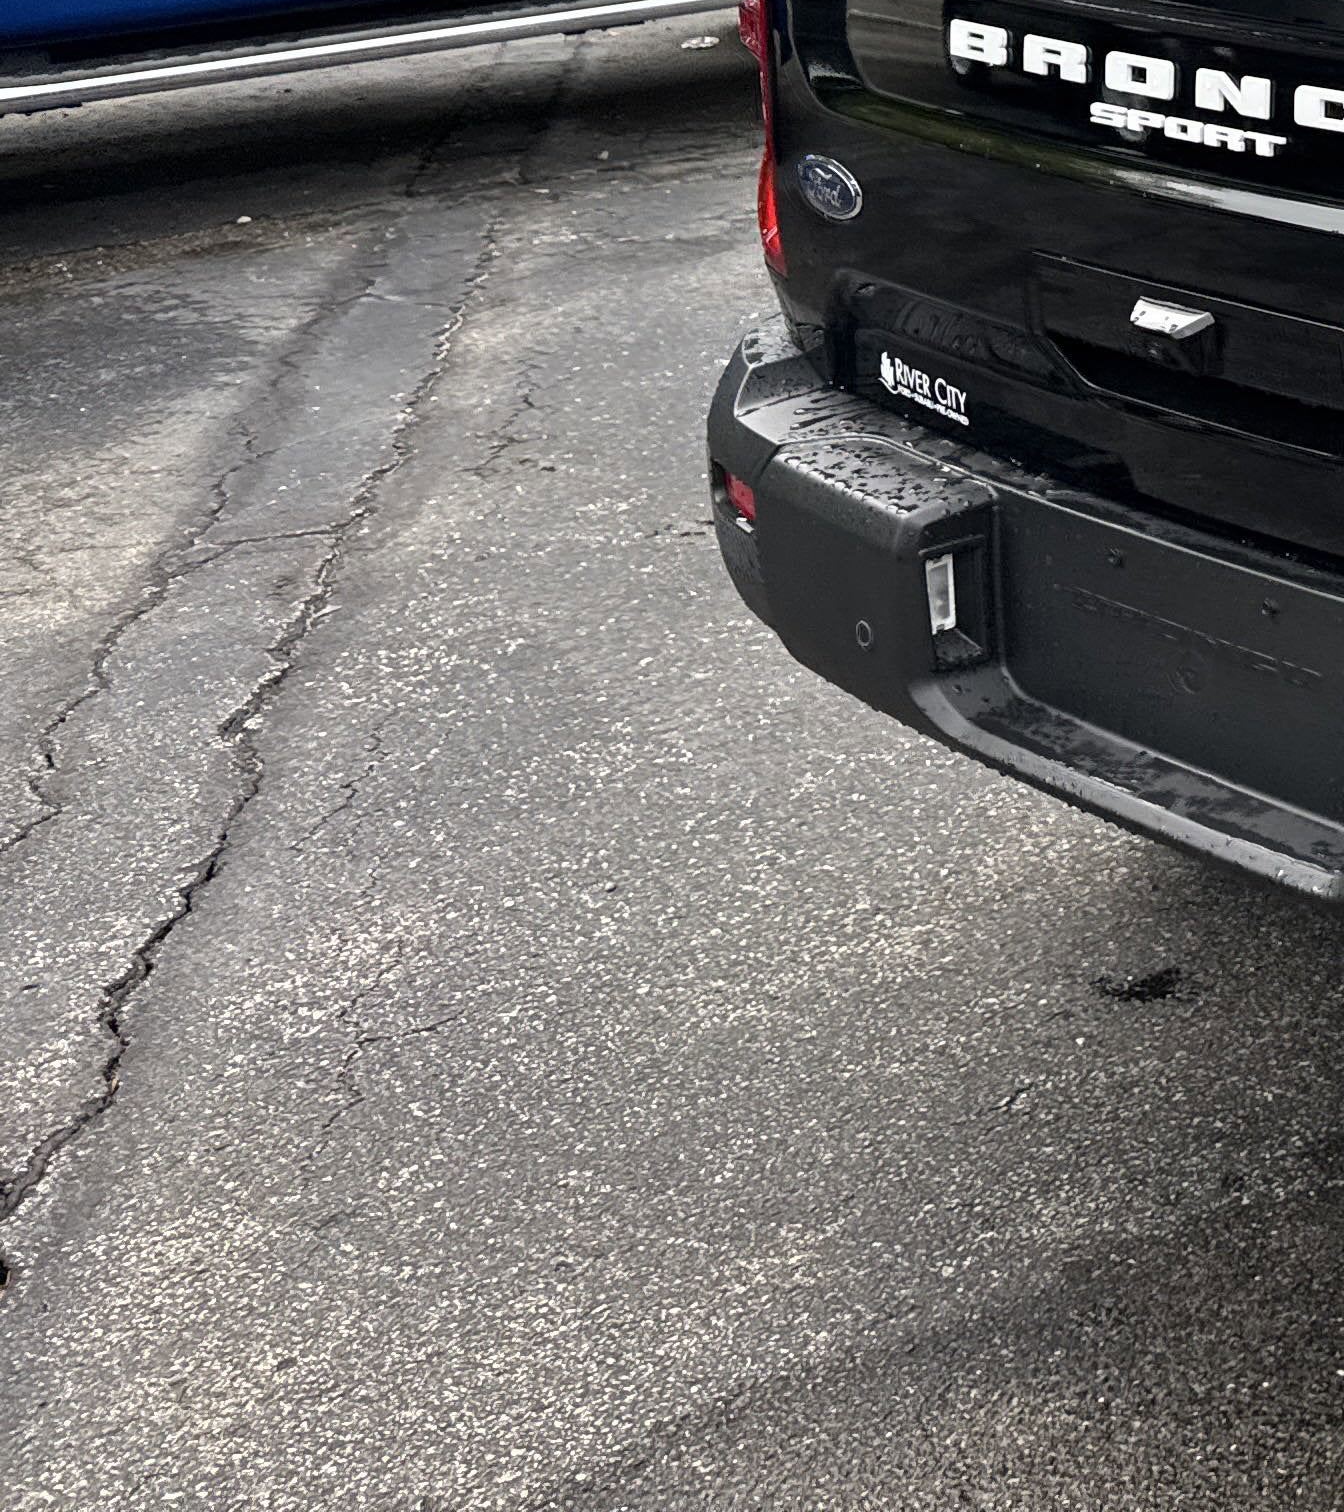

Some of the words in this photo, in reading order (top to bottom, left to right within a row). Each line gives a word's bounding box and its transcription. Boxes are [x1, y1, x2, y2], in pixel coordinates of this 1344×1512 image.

[1089, 101, 1287, 157] SPORT
[894, 357, 931, 397] RIVER
[934, 377, 966, 413] CITY
